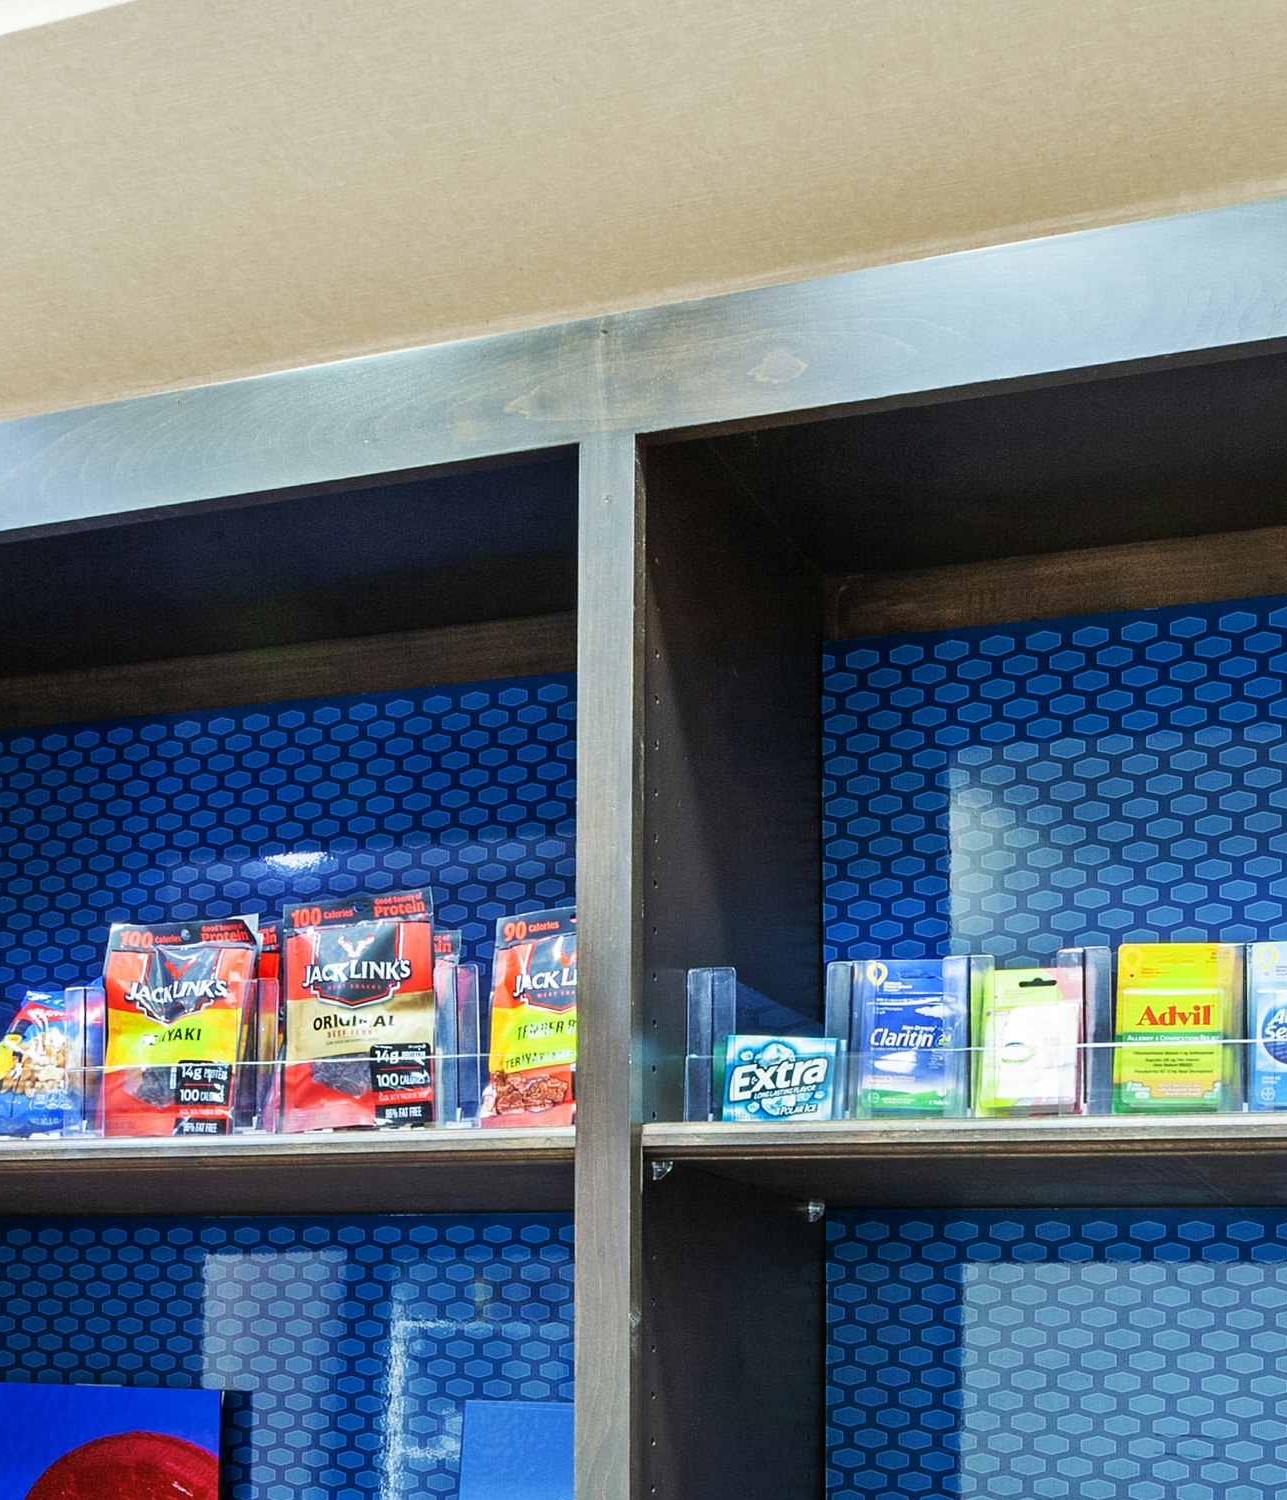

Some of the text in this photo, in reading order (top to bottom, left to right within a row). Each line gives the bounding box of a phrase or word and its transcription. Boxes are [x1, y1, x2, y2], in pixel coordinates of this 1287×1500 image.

[374, 900, 425, 918] Protein
[291, 907, 322, 928] 100
[201, 930, 250, 943] Protein
[504, 920, 527, 942] 90
[121, 931, 153, 948] 100
[302, 959, 412, 988] JACK LINK'S
[125, 979, 229, 1004] JACK LINK'S
[513, 972, 561, 997] JACK
[1136, 1005, 1211, 1026] Advil
[327, 1030, 347, 1039] BEEF
[870, 1028, 934, 1047] Claritin
[375, 1049, 399, 1064] 14g
[181, 1066, 202, 1080] 14g
[376, 1073, 399, 1087] 100
[728, 1057, 828, 1103] Extra
[180, 1089, 200, 1102] 100
[754, 1085, 816, 1099] LONG LASTING FLAVOR
[398, 1106, 423, 1118] FAT FREE
[779, 1103, 818, 1116] POLAR ICE
[205, 1122, 218, 1133] FREE
